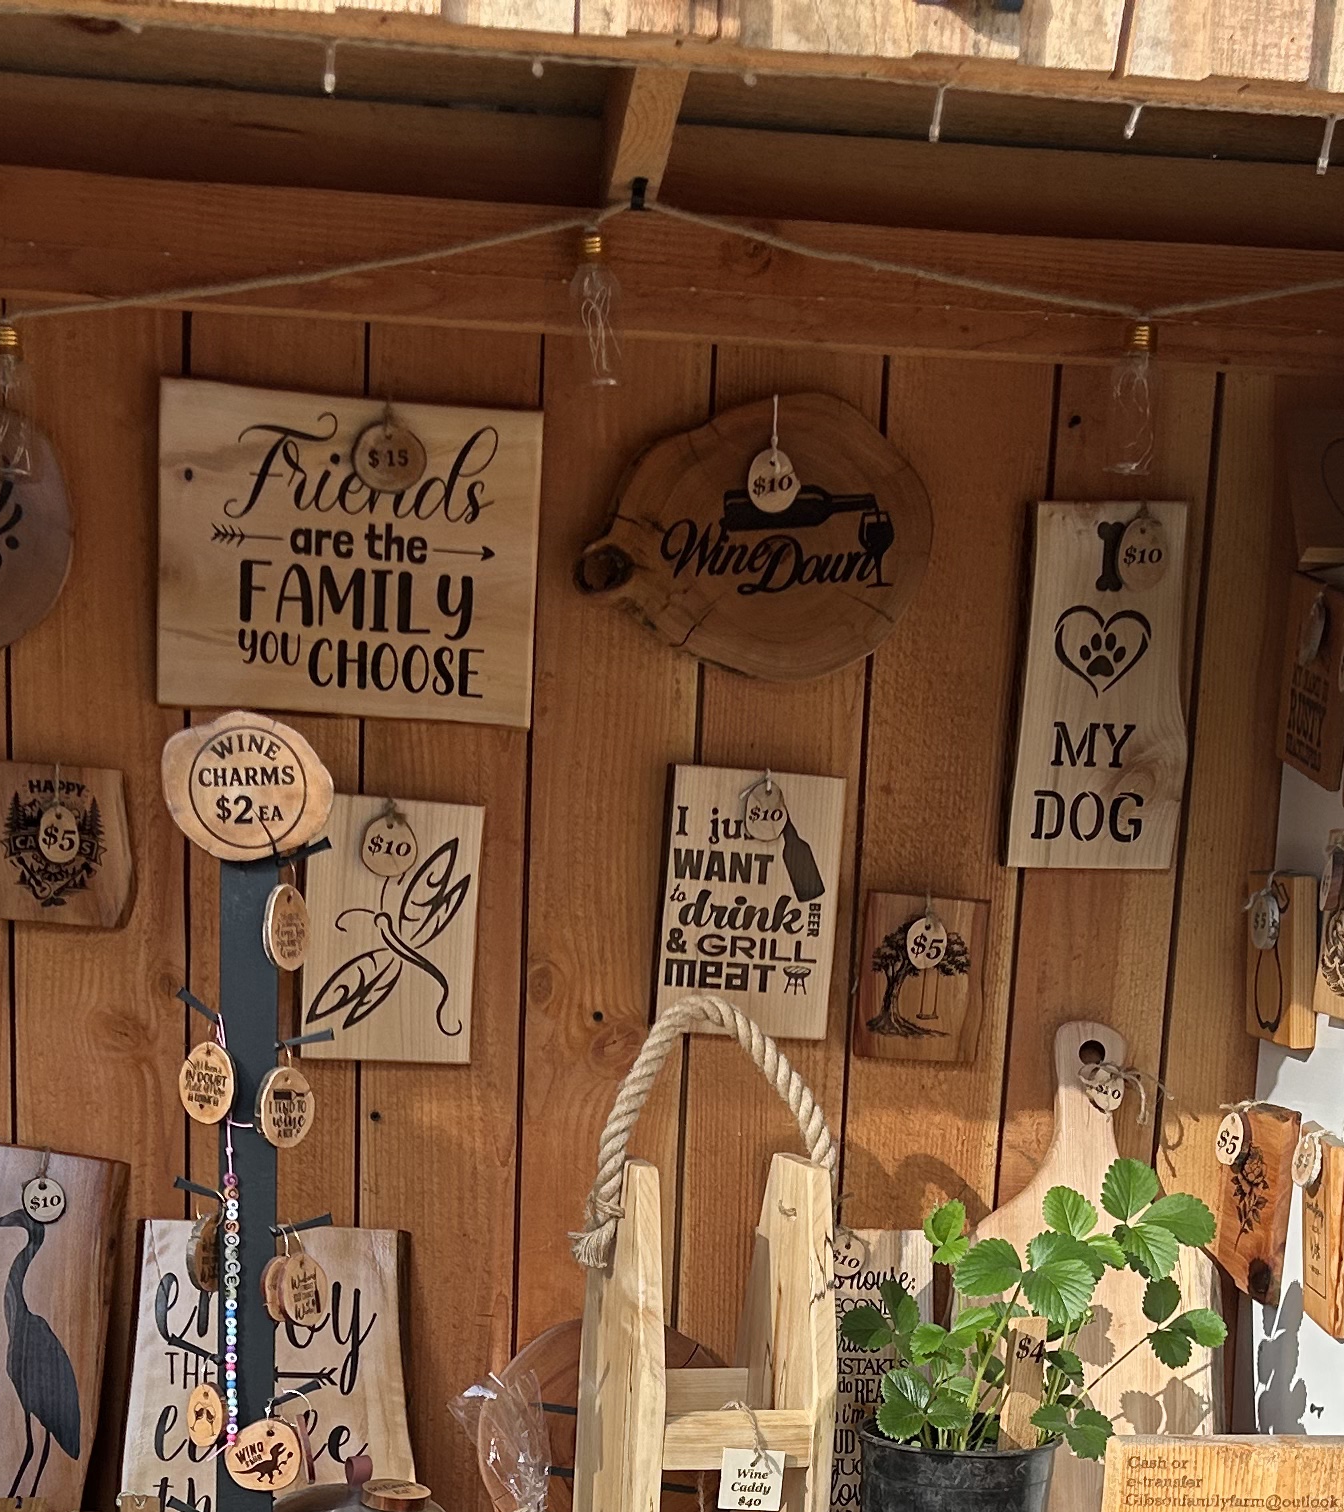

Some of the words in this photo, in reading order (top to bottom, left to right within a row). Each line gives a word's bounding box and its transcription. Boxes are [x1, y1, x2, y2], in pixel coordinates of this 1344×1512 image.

[223, 411, 498, 524] Friends
[753, 474, 792, 495] $10
[290, 527, 354, 559] are
[364, 523, 428, 564] the
[660, 517, 772, 577] Wine
[737, 533, 877, 595] Down
[1123, 545, 1163, 567] $10
[239, 559, 474, 641] FAMILY
[307, 638, 485, 699] CHOOSE
[211, 734, 281, 761] WINE
[1051, 721, 1136, 768] MY
[27, 778, 87, 798] HAPPY
[198, 765, 296, 788] CHARMS
[216, 795, 254, 825] $2
[259, 805, 284, 822] EA
[675, 806, 688, 836] I
[749, 807, 783, 822] $10
[1030, 790, 1144, 843] DOG
[42, 823, 77, 853] $5
[368, 836, 411, 857] $10
[674, 848, 774, 885] WANT
[670, 884, 686, 901] to
[678, 889, 804, 935] drink
[807, 902, 821, 938] BEER
[666, 927, 687, 954] &
[697, 934, 817, 964] GRILL
[910, 933, 944, 962] $5
[1217, 1128, 1240, 1156] $5
[29, 1195, 62, 1210] $10
[1016, 1336, 1044, 1364] $4
[839, 1376, 852, 1394] do
[235, 1441, 264, 1466] WINO
[1128, 1456, 1168, 1469] Cash
[1171, 1458, 1188, 1470] or
[737, 1468, 769, 1480] Wine
[1126, 1475, 1204, 1488] e-transfer
[731, 1482, 771, 1495] Caddy
[737, 1496, 762, 1508] $40
